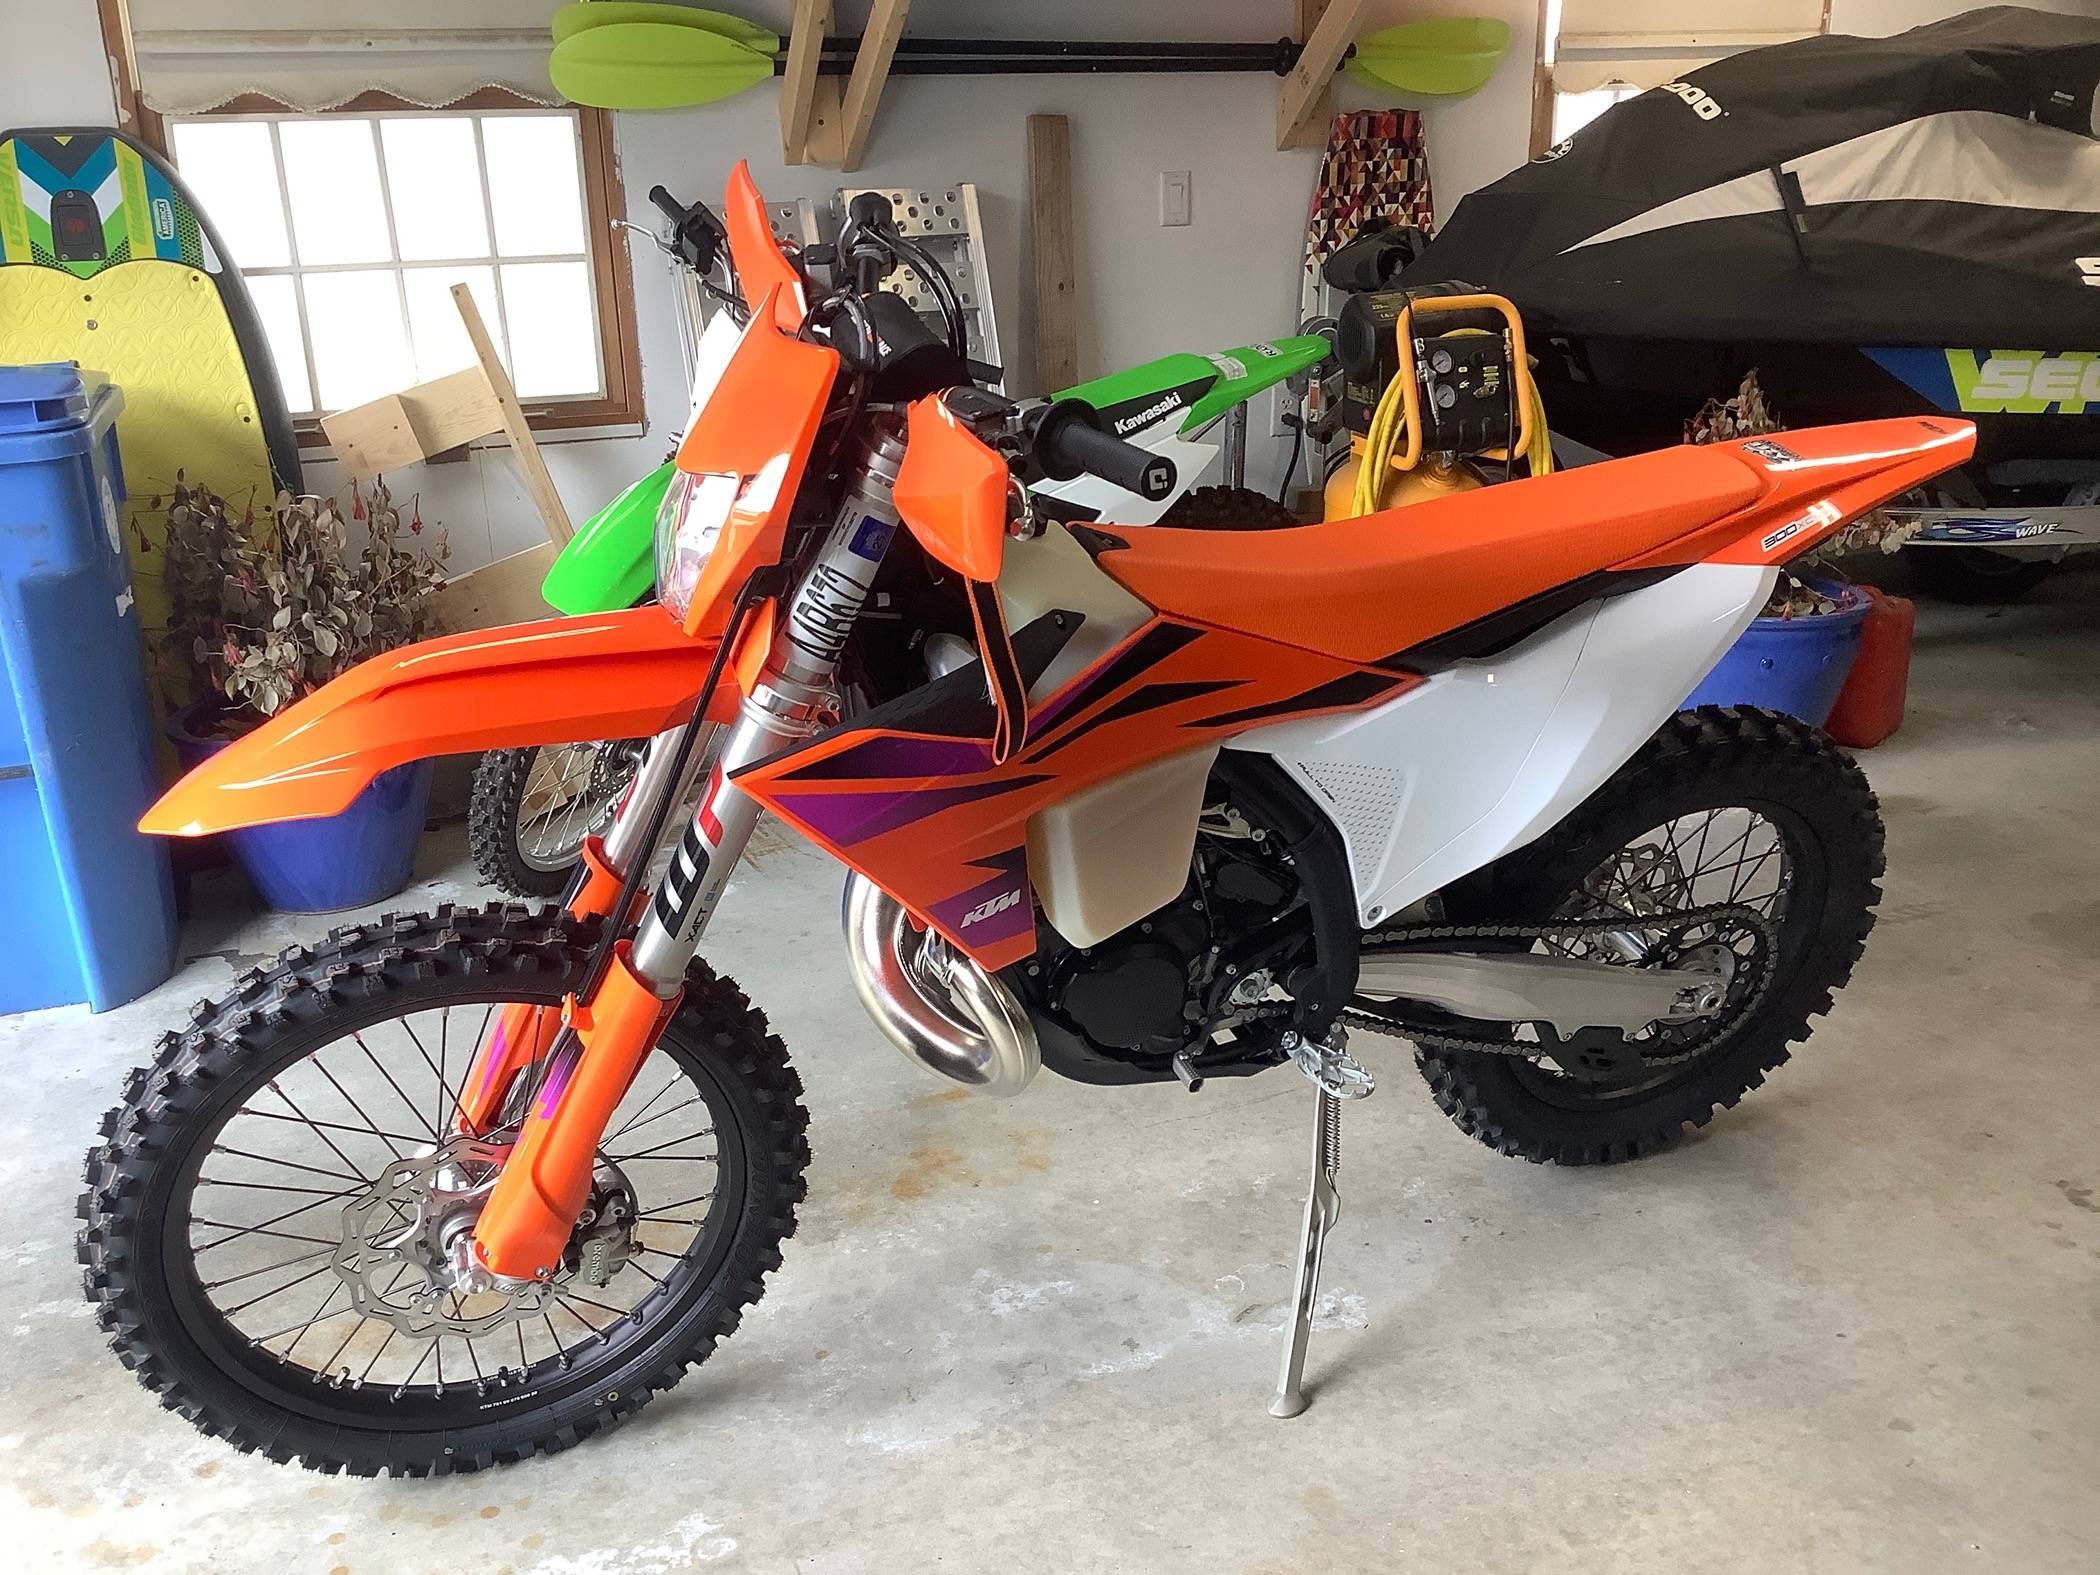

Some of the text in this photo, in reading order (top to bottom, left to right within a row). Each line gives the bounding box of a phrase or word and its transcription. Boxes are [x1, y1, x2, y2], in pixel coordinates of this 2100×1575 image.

[1114, 391, 1183, 435] Kawasaki
[2015, 523, 2058, 539] WAVE
[684, 907, 709, 944] XACT
[960, 888, 1021, 929] KTM
[590, 1243, 606, 1282] brembo
